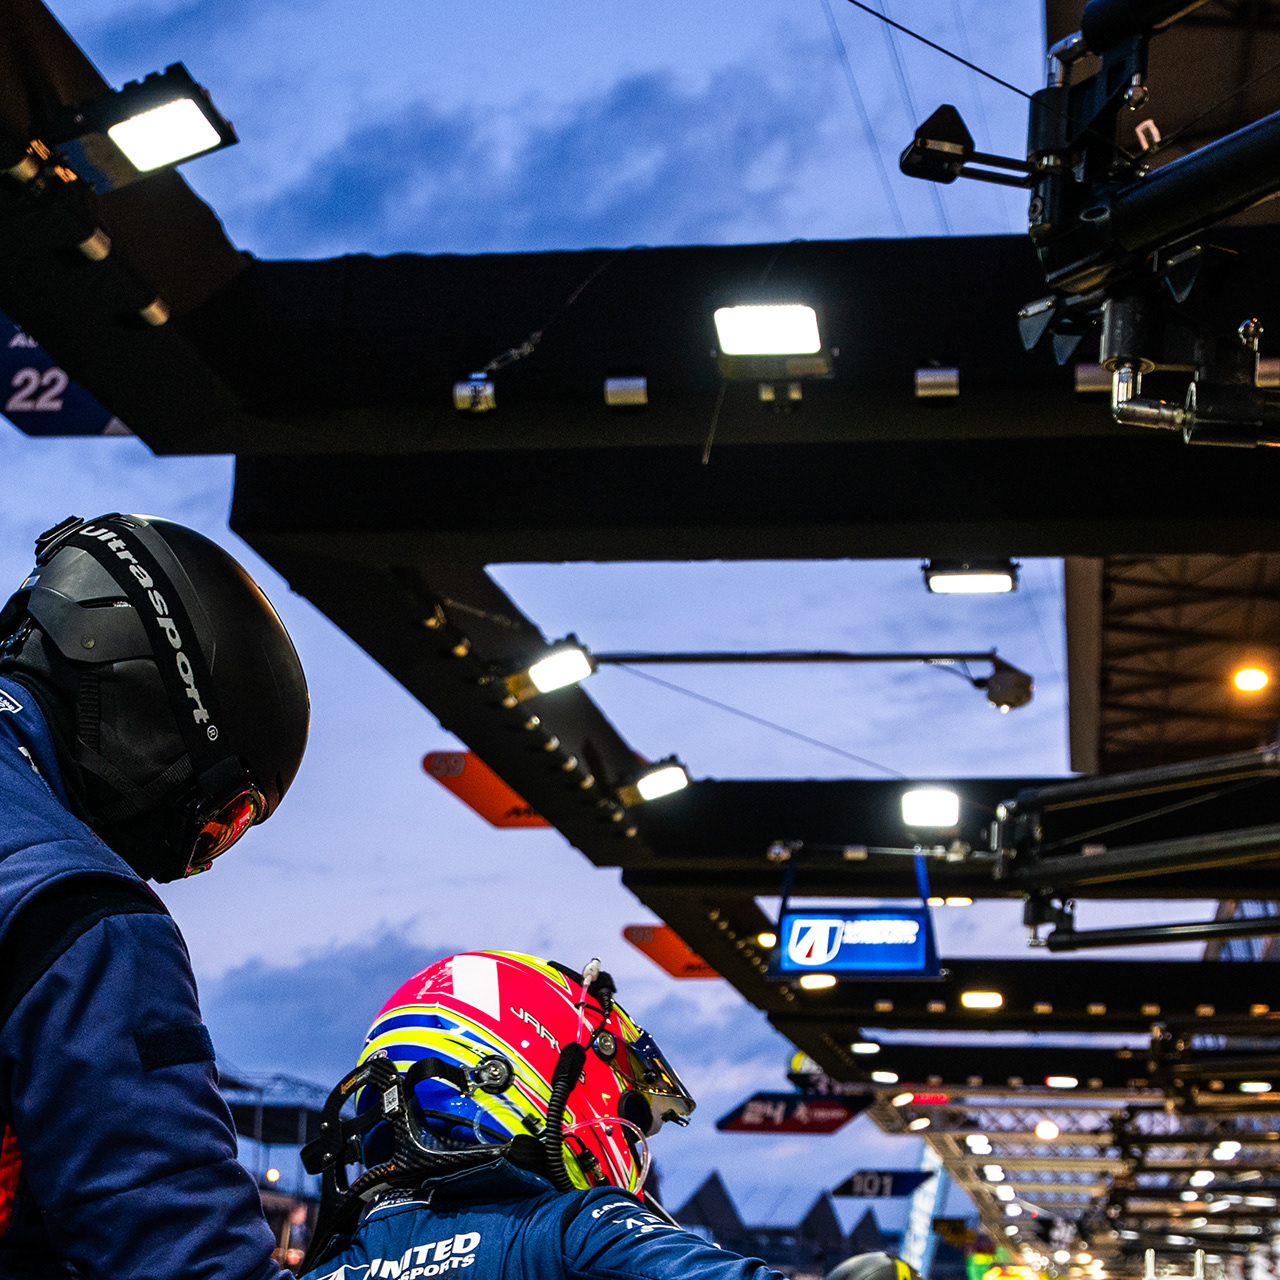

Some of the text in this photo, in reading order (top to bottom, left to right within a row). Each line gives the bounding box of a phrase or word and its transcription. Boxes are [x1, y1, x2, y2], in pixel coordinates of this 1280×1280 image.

[4, 366, 69, 411] 22
[741, 1100, 787, 1126] 24
[852, 1175, 894, 1197] 101
